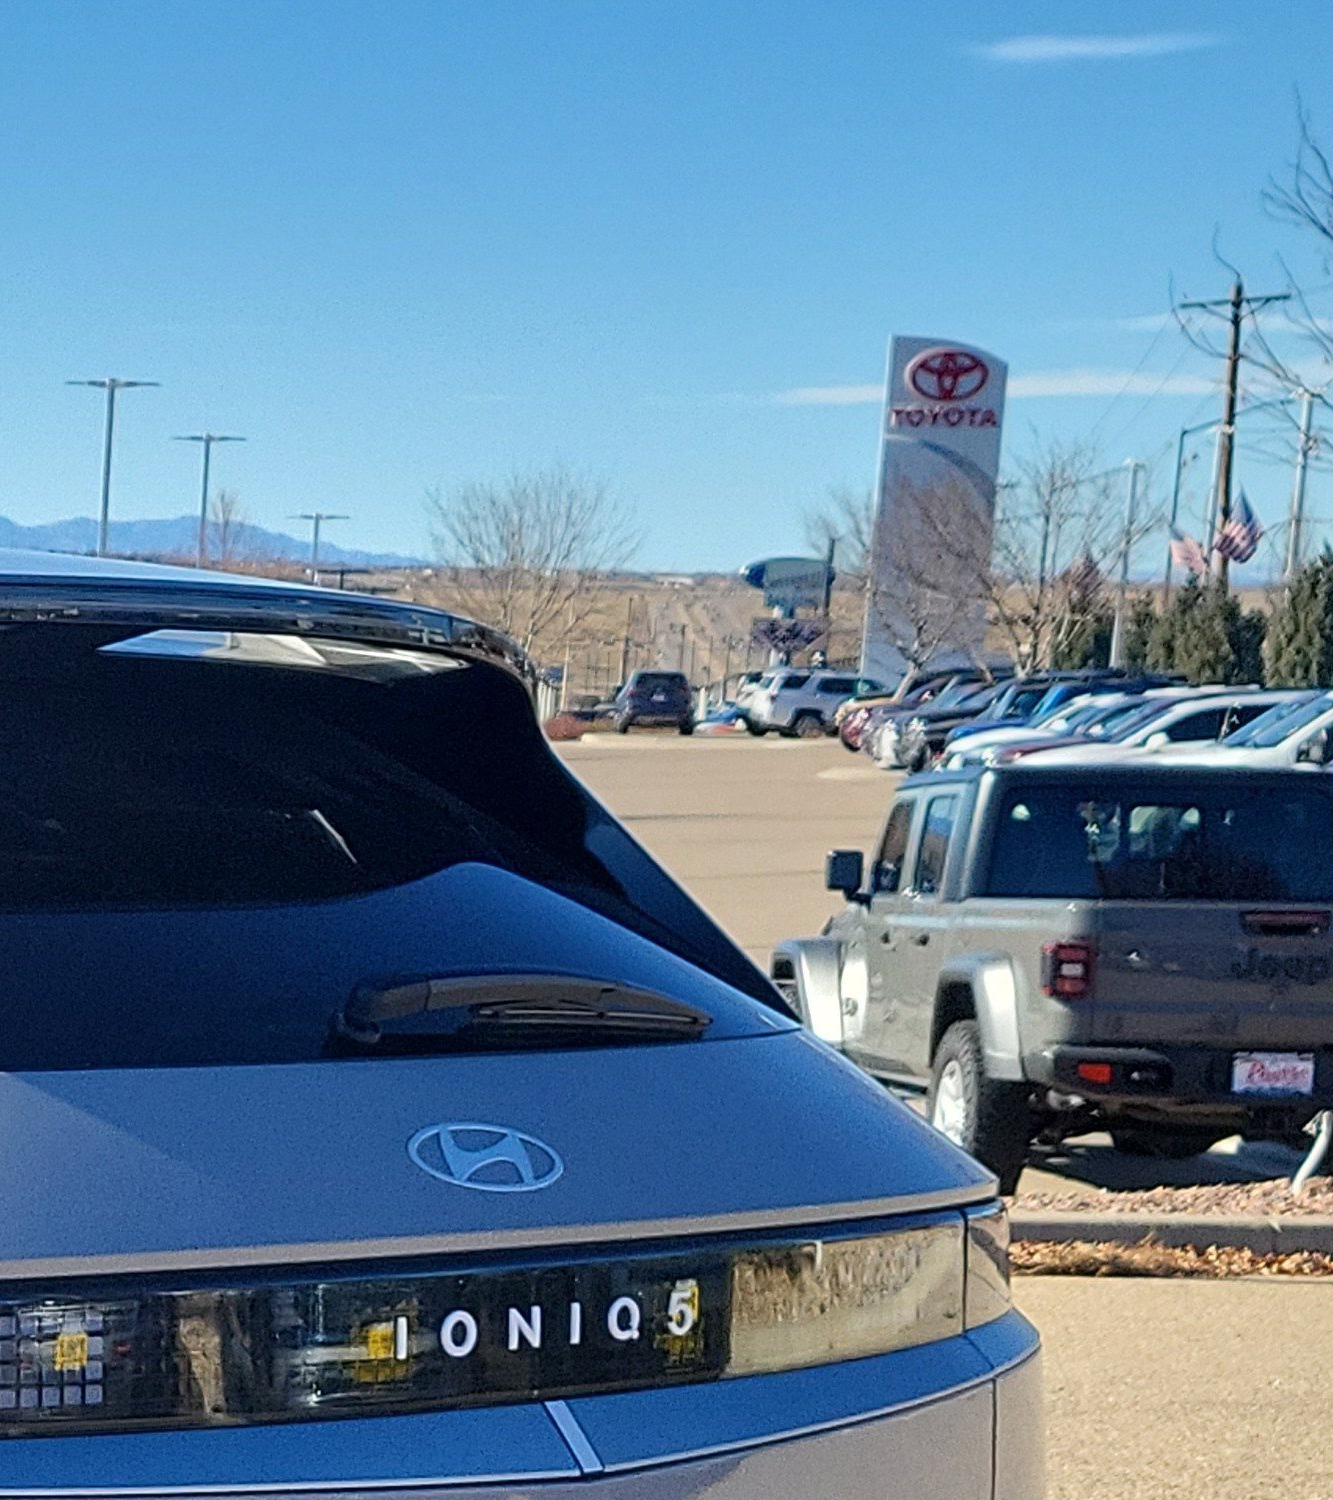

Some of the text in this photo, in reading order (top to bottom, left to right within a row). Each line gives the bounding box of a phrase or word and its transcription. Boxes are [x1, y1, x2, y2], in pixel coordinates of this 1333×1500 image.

[890, 408, 998, 427] TOYOTA
[396, 1289, 694, 1360] IONIQ 5
